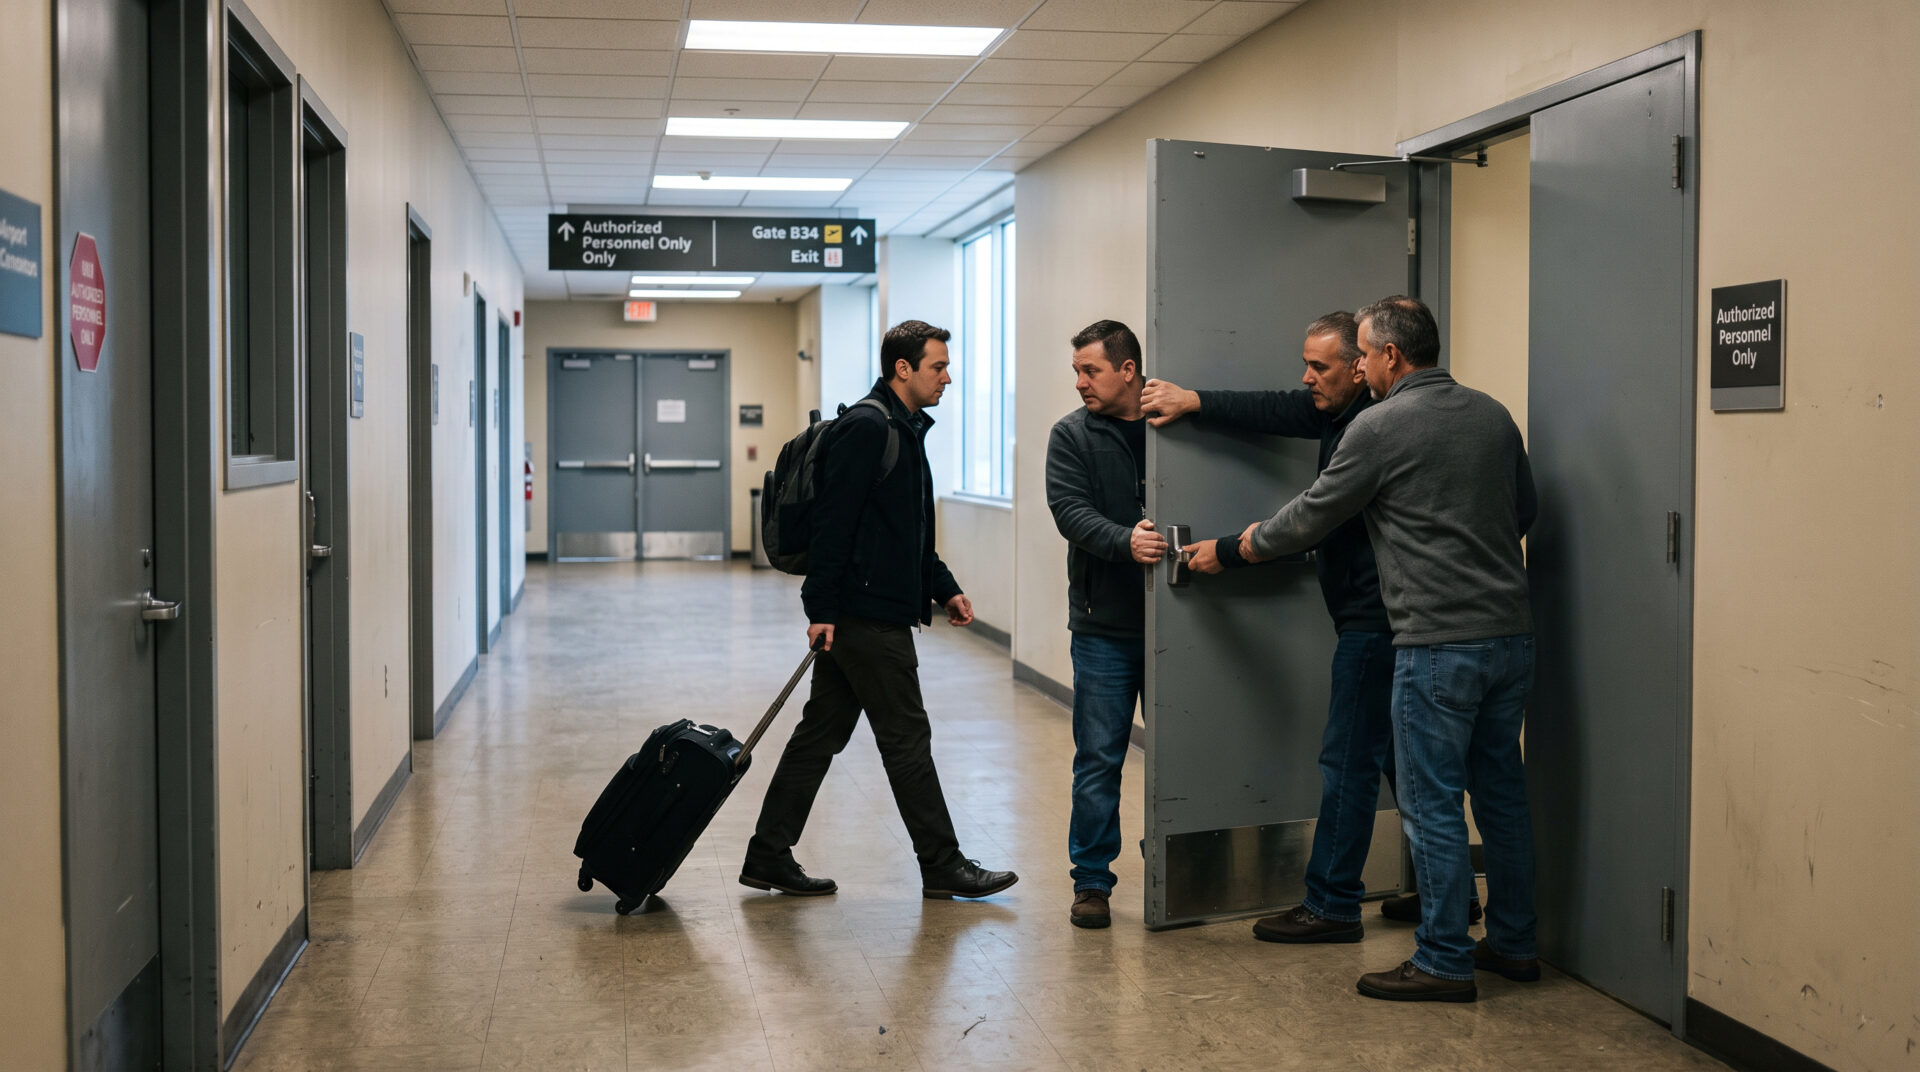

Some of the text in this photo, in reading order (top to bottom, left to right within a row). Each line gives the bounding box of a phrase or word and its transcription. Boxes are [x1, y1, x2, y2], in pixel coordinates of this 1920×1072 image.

[582, 220, 662, 234] Authorized
[752, 225, 819, 240] Gate B34
[582, 236, 692, 254] Personnel Only
[582, 250, 617, 268] Only
[791, 249, 819, 263] Exit
[1716, 300, 1775, 325] Authorized
[1719, 323, 1771, 345] Personnel
[1732, 347, 1757, 369] Only
